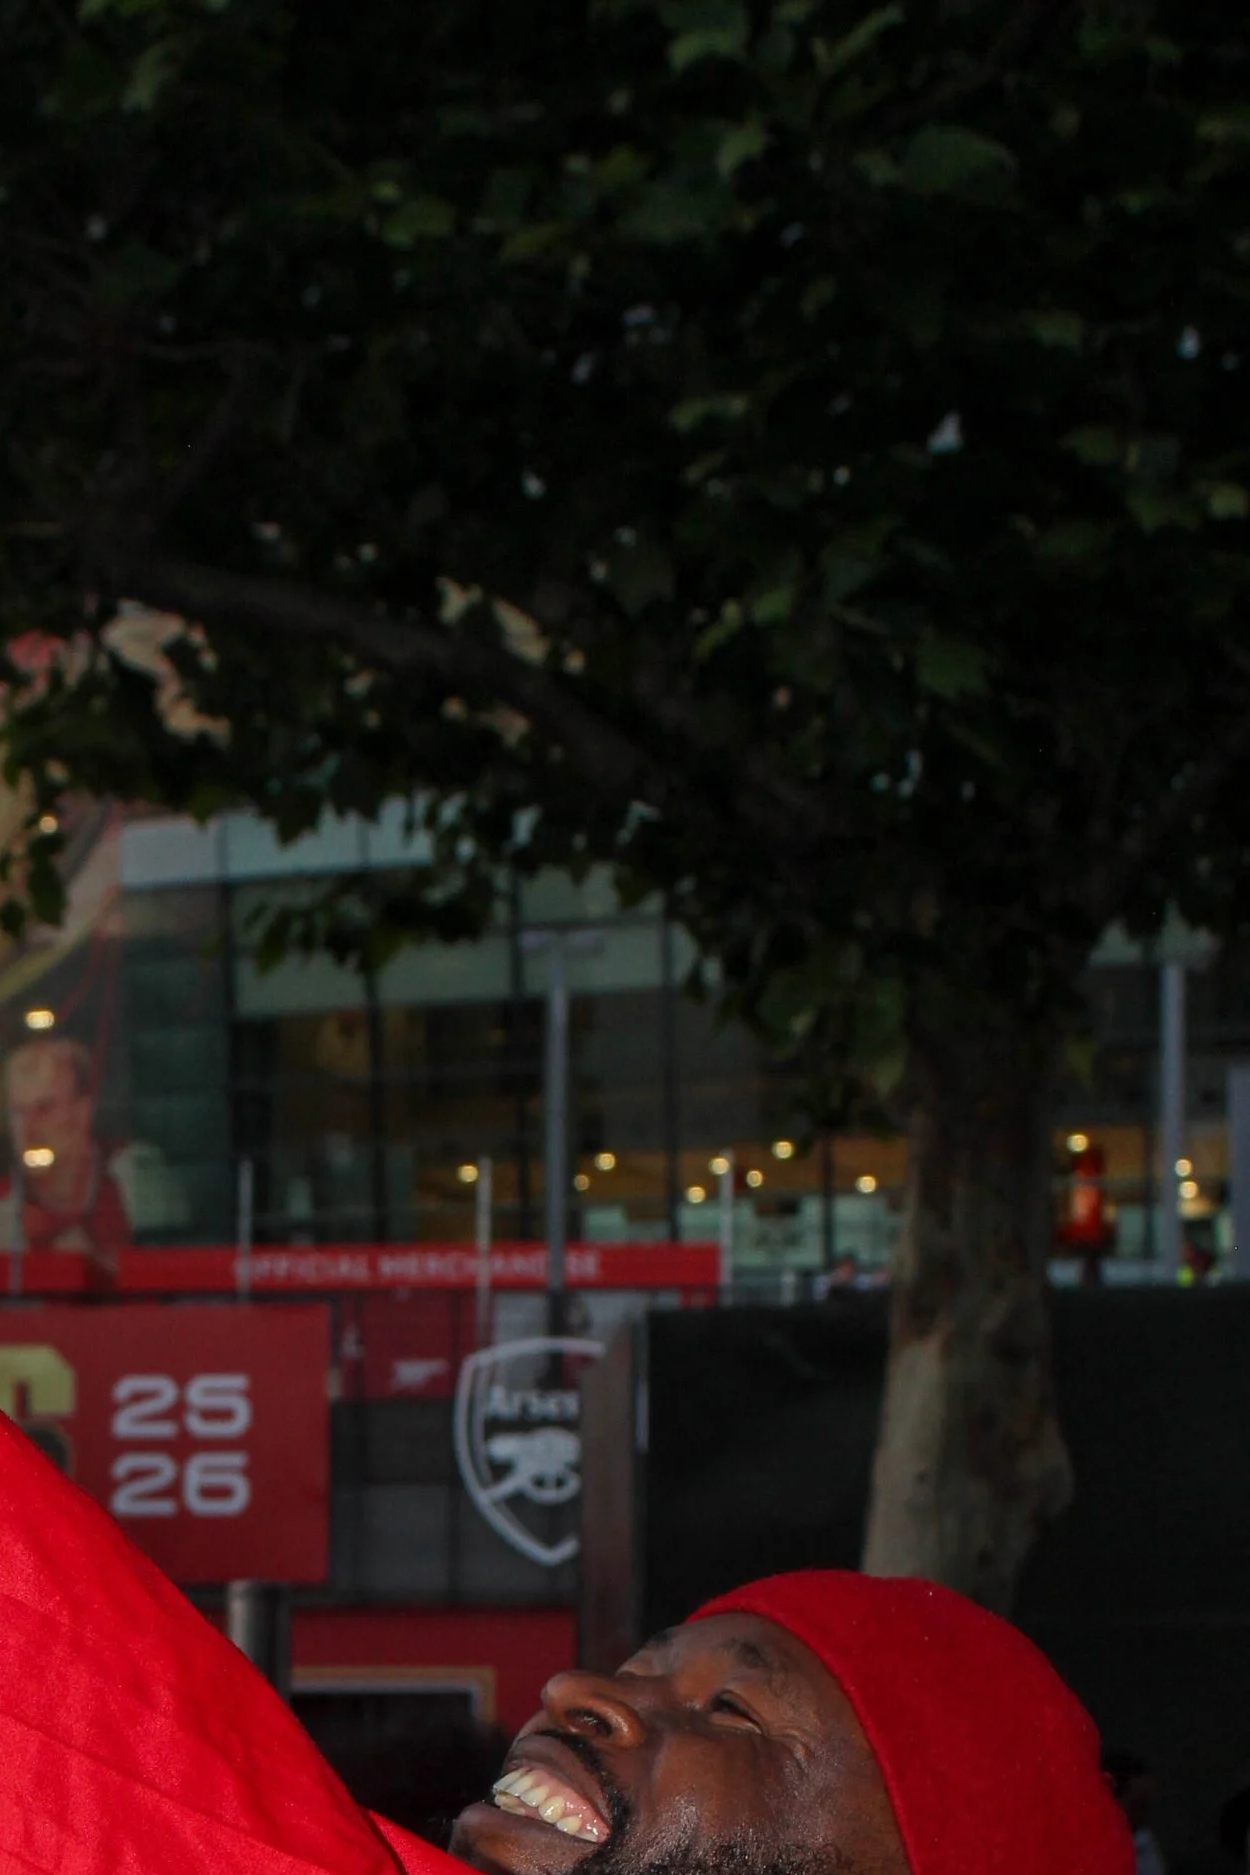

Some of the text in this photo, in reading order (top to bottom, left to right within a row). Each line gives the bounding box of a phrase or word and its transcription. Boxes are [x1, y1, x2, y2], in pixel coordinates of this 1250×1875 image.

[378, 1248, 599, 1282] MERCHANDSE
[112, 1373, 252, 1440] 25
[111, 1451, 252, 1517] 26
